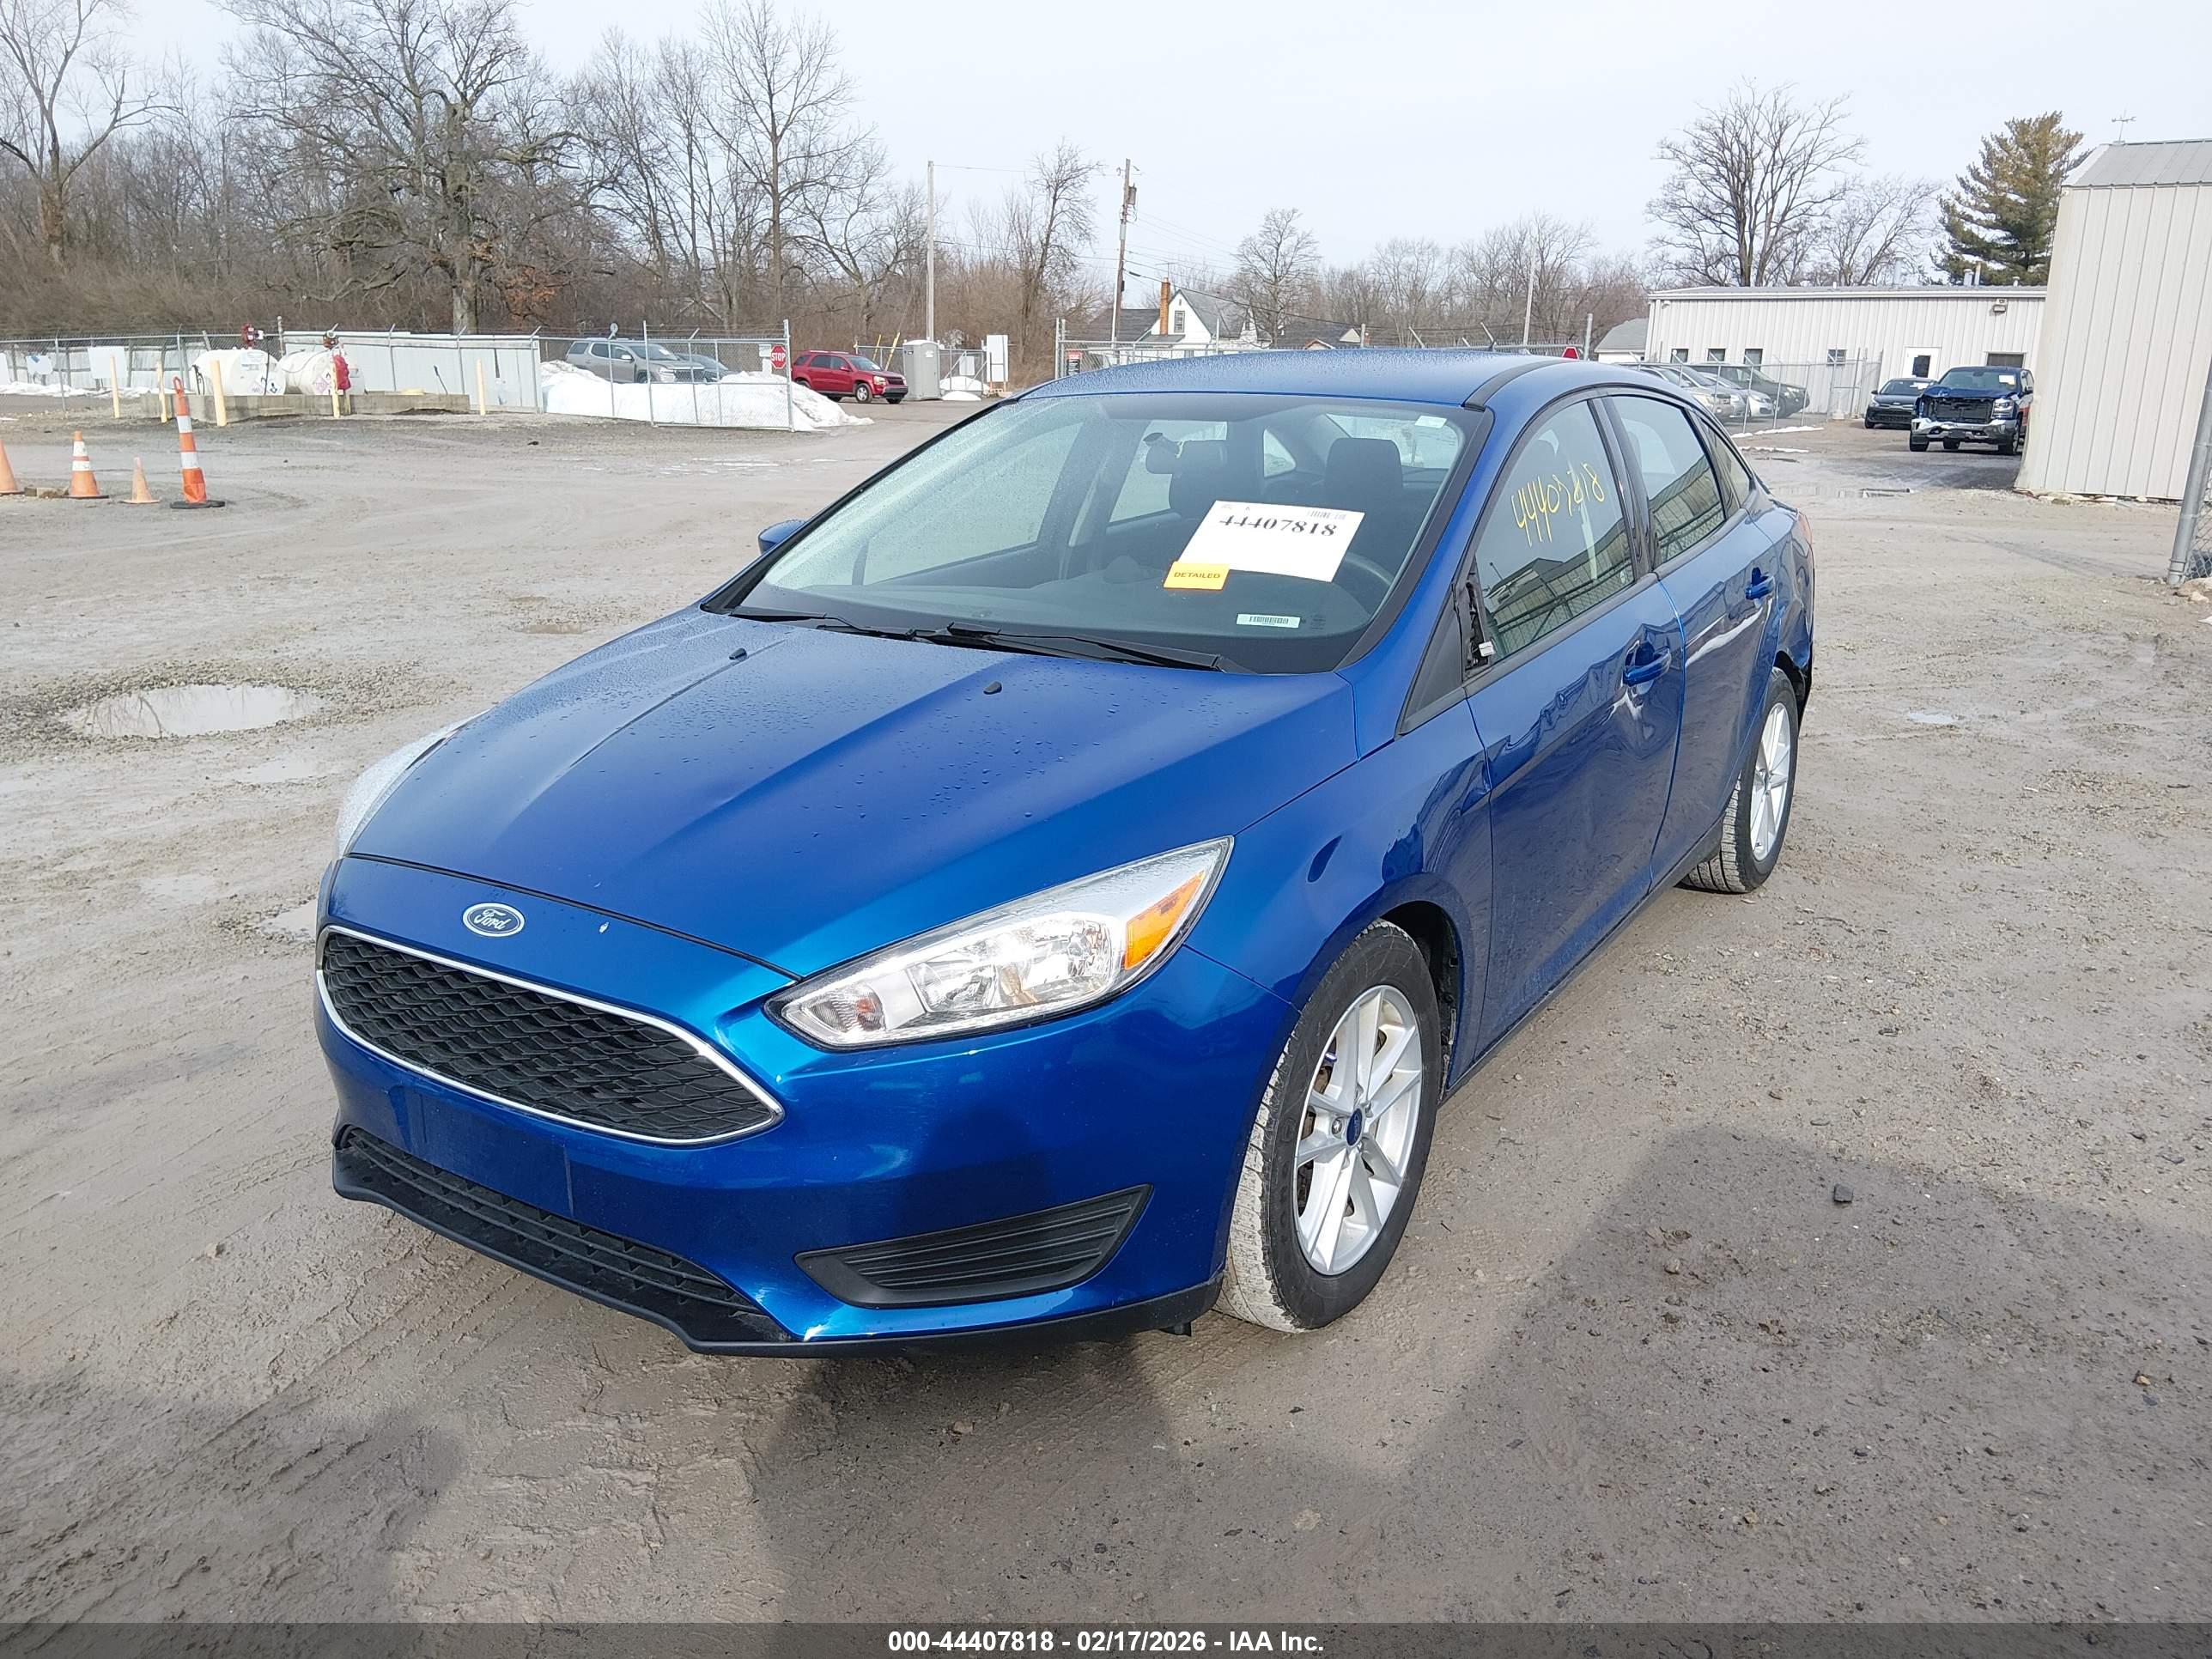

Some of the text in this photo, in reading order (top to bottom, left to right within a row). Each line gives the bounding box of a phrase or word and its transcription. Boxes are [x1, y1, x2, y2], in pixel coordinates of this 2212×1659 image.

[771, 352, 786, 362] STOP
[1219, 514, 1338, 537] 44407818
[473, 908, 512, 930] Ford
